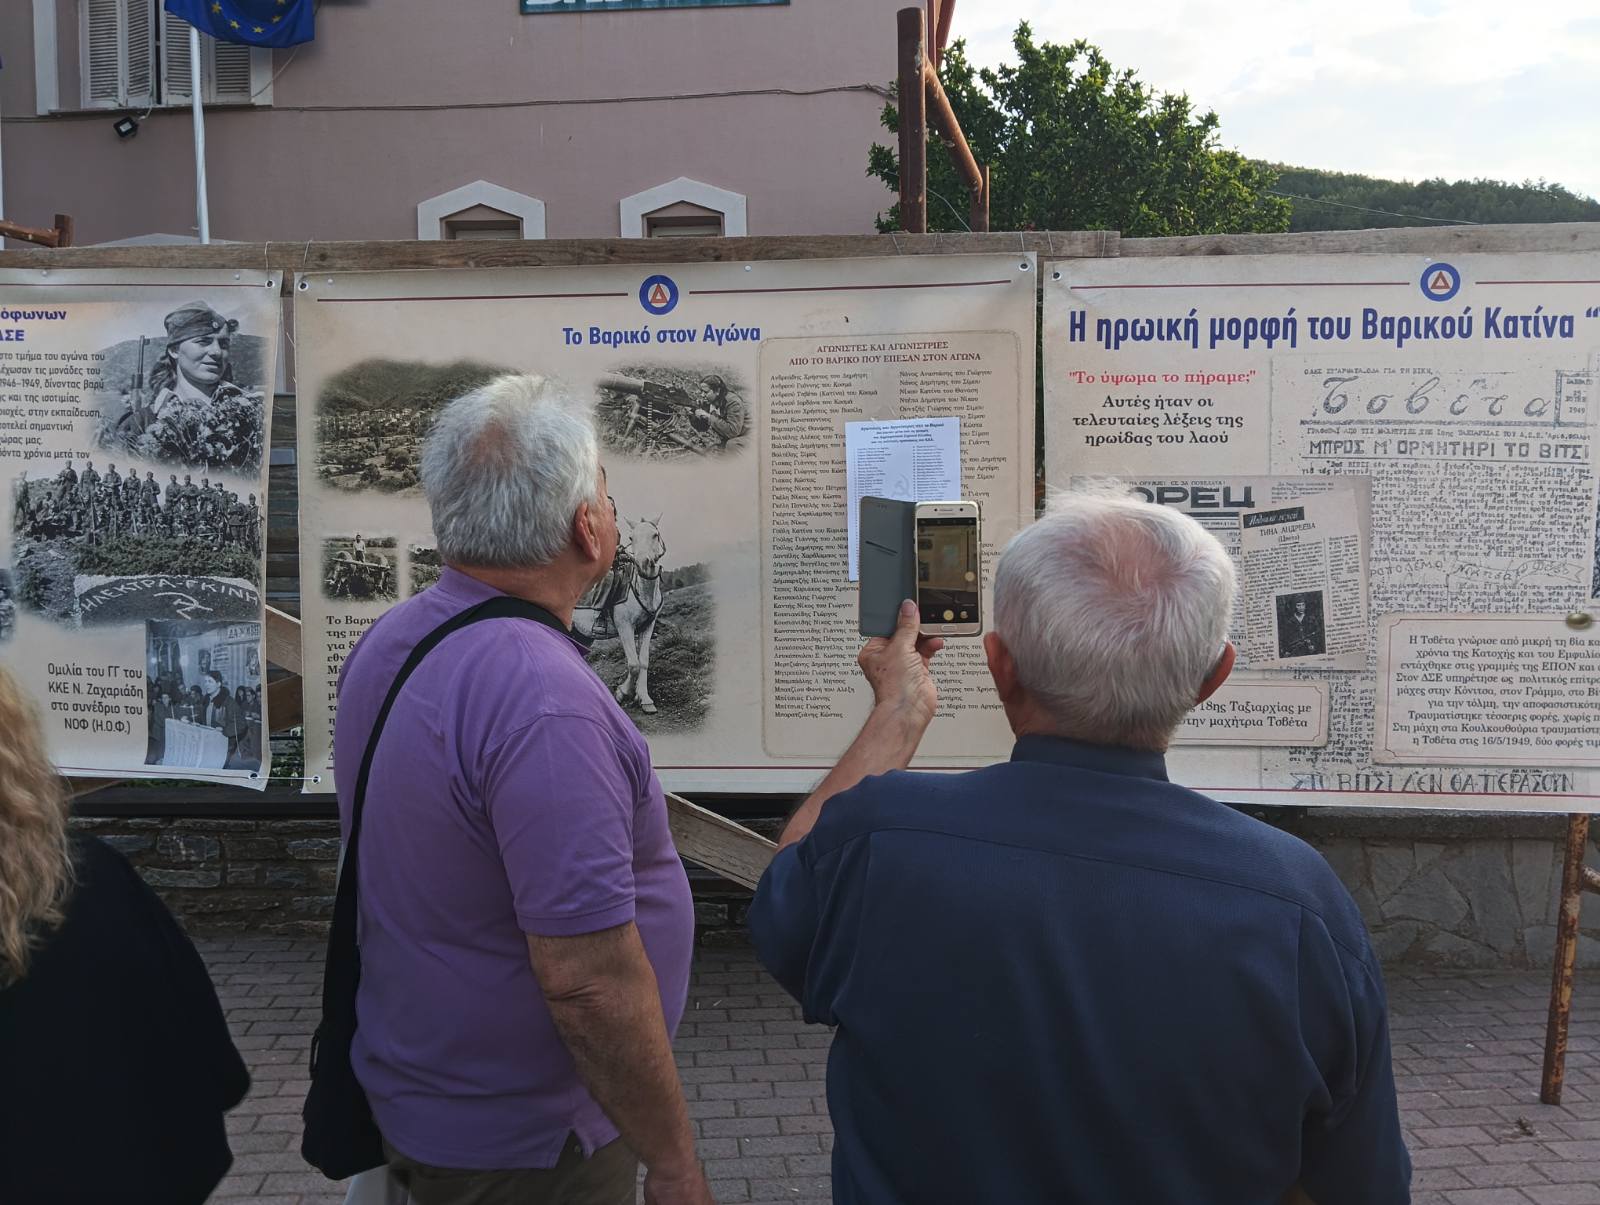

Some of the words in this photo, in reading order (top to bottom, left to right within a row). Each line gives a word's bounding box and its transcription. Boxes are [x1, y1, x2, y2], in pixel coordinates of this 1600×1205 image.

[1069, 310, 1086, 342] Η
[1096, 308, 1201, 350] ηρωική
[1209, 307, 1298, 349] μορφή
[1307, 315, 1351, 340] του
[1361, 306, 1473, 348] Βαρικού
[1484, 305, 1575, 339] Κατίνα
[563, 327, 583, 345] Το
[589, 325, 651, 349] Βαρικό
[656, 328, 697, 343] στον
[702, 323, 761, 346] Αγώνα
[817, 344, 867, 353] ΑΓΩΝΙΣΤΕΣ
[870, 344, 886, 352] ΚΑΙ
[888, 341, 949, 351] ΑΓΩΝΙΣΤΡΙΕΣ
[16, 350, 42, 362] τμήμα
[44, 353, 58, 361] του
[61, 350, 88, 363] αγώνα
[91, 353, 105, 361] του
[789, 357, 809, 366] ΑΠΟ
[826, 356, 860, 365] ΒΑΡΙΚΟ
[862, 355, 881, 363] ΠΟΥ
[883, 354, 920, 363] ΕΠΕΣΑΝ
[922, 353, 948, 361] ΣΤΟΝ
[950, 352, 981, 361] ΑΓΩΝΑ
[35, 367, 47, 375] τις
[49, 364, 84, 376] μονάδες
[86, 367, 101, 375] του
[1101, 369, 1157, 386] ύψωμα
[1162, 373, 1180, 384] το
[45, 378, 81, 390] δίνοντας
[84, 379, 105, 391] βαρύ
[24, 395, 39, 404] της
[1101, 394, 1151, 409] Αυτές
[1155, 395, 1193, 410] ήταν
[1197, 398, 1214, 408] οι
[28, 409, 49, 418] στην
[30, 421, 74, 433] σημαντική
[1072, 412, 1160, 428] τελευταίες
[1163, 412, 1213, 429] λέξεις
[1216, 415, 1244, 428] της
[1084, 431, 1153, 447] ηρωίδας
[1156, 433, 1185, 444] του
[1188, 430, 1230, 444] λαού
[24, 448, 52, 460] χρόνια
[54, 449, 73, 460] μετά
[77, 451, 91, 459] τον
[1309, 440, 1365, 455] ΜΠΡΟΣ
[1397, 440, 1496, 457] ΟΡΜΗΤΗΡΙ
[1503, 442, 1530, 458] ΤΟ
[1128, 486, 1256, 508] ОРЕЦ
[326, 615, 341, 625] Το
[326, 630, 347, 639] της
[326, 643, 346, 652] για
[1409, 635, 1418, 645] Η
[1458, 635, 1498, 647] γνώρισε
[1500, 636, 1519, 645] από
[1522, 636, 1552, 648] μικρή
[1555, 639, 1567, 648] τη
[1416, 648, 1449, 659] χρόνια
[1453, 650, 1469, 659] της
[1472, 648, 1515, 660] Κατοχής
[47, 662, 83, 677] Ομιλία
[86, 667, 105, 677] του
[107, 665, 120, 678] ΓΓ
[123, 669, 143, 679] του
[1400, 660, 1453, 672] εντάχθηκε
[1455, 663, 1475, 672] στις
[1478, 661, 1519, 673] γραμμές
[1522, 664, 1539, 673] της
[1541, 661, 1577, 671] ΕΠΟΝ
[1579, 664, 1595, 672] και
[1396, 672, 1419, 682] Στον
[1422, 672, 1443, 682] ΔΣΕ
[1446, 673, 1498, 685] υπηρέτησε
[1501, 675, 1514, 685] ως
[1519, 674, 1568, 686] πολιτικός
[48, 681, 70, 694] ΚΚΕ
[73, 682, 84, 695] Ν.
[87, 683, 144, 699] Ζαχαριάδη
[1397, 685, 1426, 696] μάχες
[1428, 687, 1451, 696] στην
[1454, 685, 1497, 697] Κόνιτσα,
[1500, 687, 1523, 695] στον
[1525, 686, 1566, 698] Γράμμο,
[1568, 689, 1585, 697] στο
[51, 701, 69, 711] στο
[72, 700, 121, 716] συνέδριο
[124, 705, 143, 715] του
[1200, 701, 1226, 713] 18ης
[1230, 701, 1295, 715] Ταξιαρχίας
[1297, 704, 1312, 715] με
[1428, 700, 1444, 709] για
[1446, 700, 1465, 709] την
[1466, 698, 1499, 710] τόλμη,
[1503, 700, 1521, 710] την
[1209, 715, 1264, 729] μαχήτρια
[1408, 710, 1483, 722] Τραυματίστηκε
[1485, 711, 1528, 723] τέσσερις
[1529, 712, 1560, 724] φορές,
[1563, 712, 1591, 724] χωρίς
[64, 717, 89, 730] ΝΟΦ
[92, 718, 131, 735] (Η.Ο.Φ.)
[1392, 722, 1411, 734] Στη
[1413, 722, 1439, 734] μάχη
[1441, 725, 1458, 733] στα
[1461, 723, 1538, 735] Κουλκουθούρια
[1412, 737, 1420, 746] η
[1459, 738, 1479, 747] στις
[1482, 736, 1533, 747] 16/5/1949,
[1535, 736, 1553, 746] δύο
[1555, 737, 1584, 748] φορές
